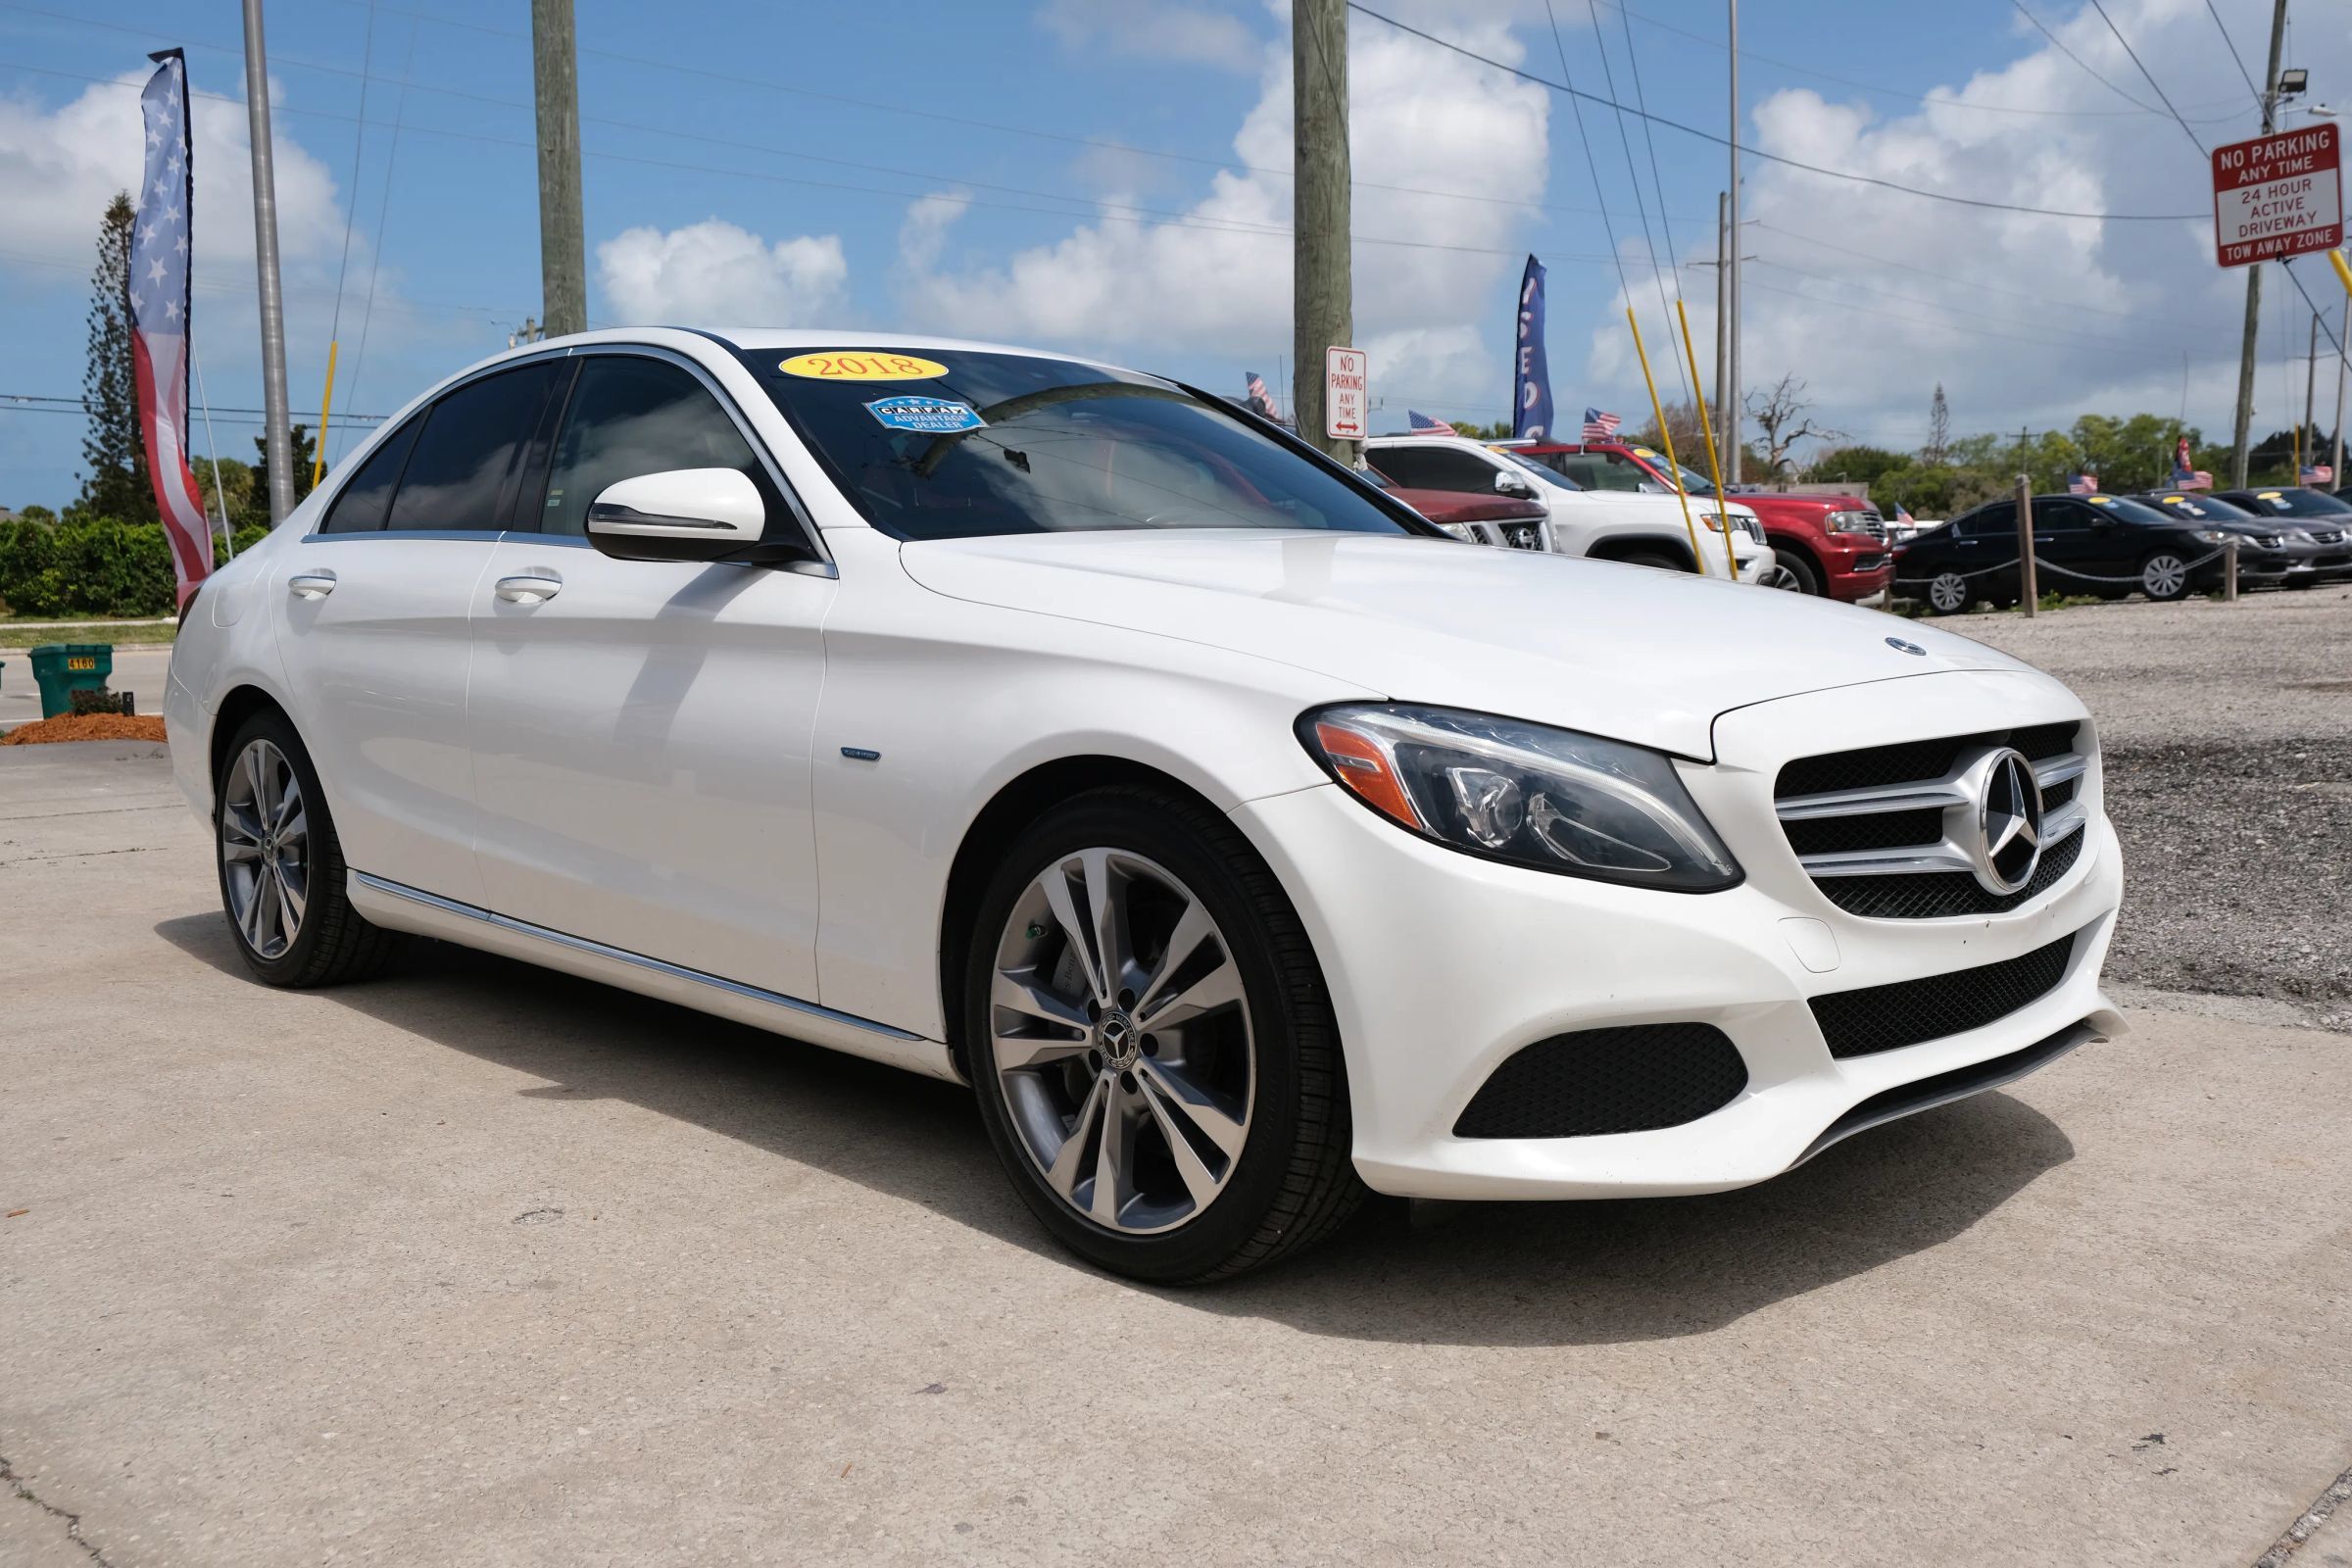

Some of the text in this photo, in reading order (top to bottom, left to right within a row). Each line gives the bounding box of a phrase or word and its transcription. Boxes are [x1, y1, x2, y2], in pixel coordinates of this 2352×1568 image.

[2221, 130, 2329, 171] NO PARKING
[2238, 156, 2314, 183] ANY TIME
[2242, 178, 2312, 204] 24 HOUR
[2251, 196, 2305, 219] ACTIVE
[2238, 211, 2318, 238] DRIVEWAY
[2227, 228, 2333, 261] TOW AWAY ZONE
[808, 358, 923, 376] 2018
[1341, 356, 1354, 372] NO
[1331, 373, 1363, 390] PARKING
[1340, 393, 1354, 406] ANY
[1339, 406, 1356, 419] TIME
